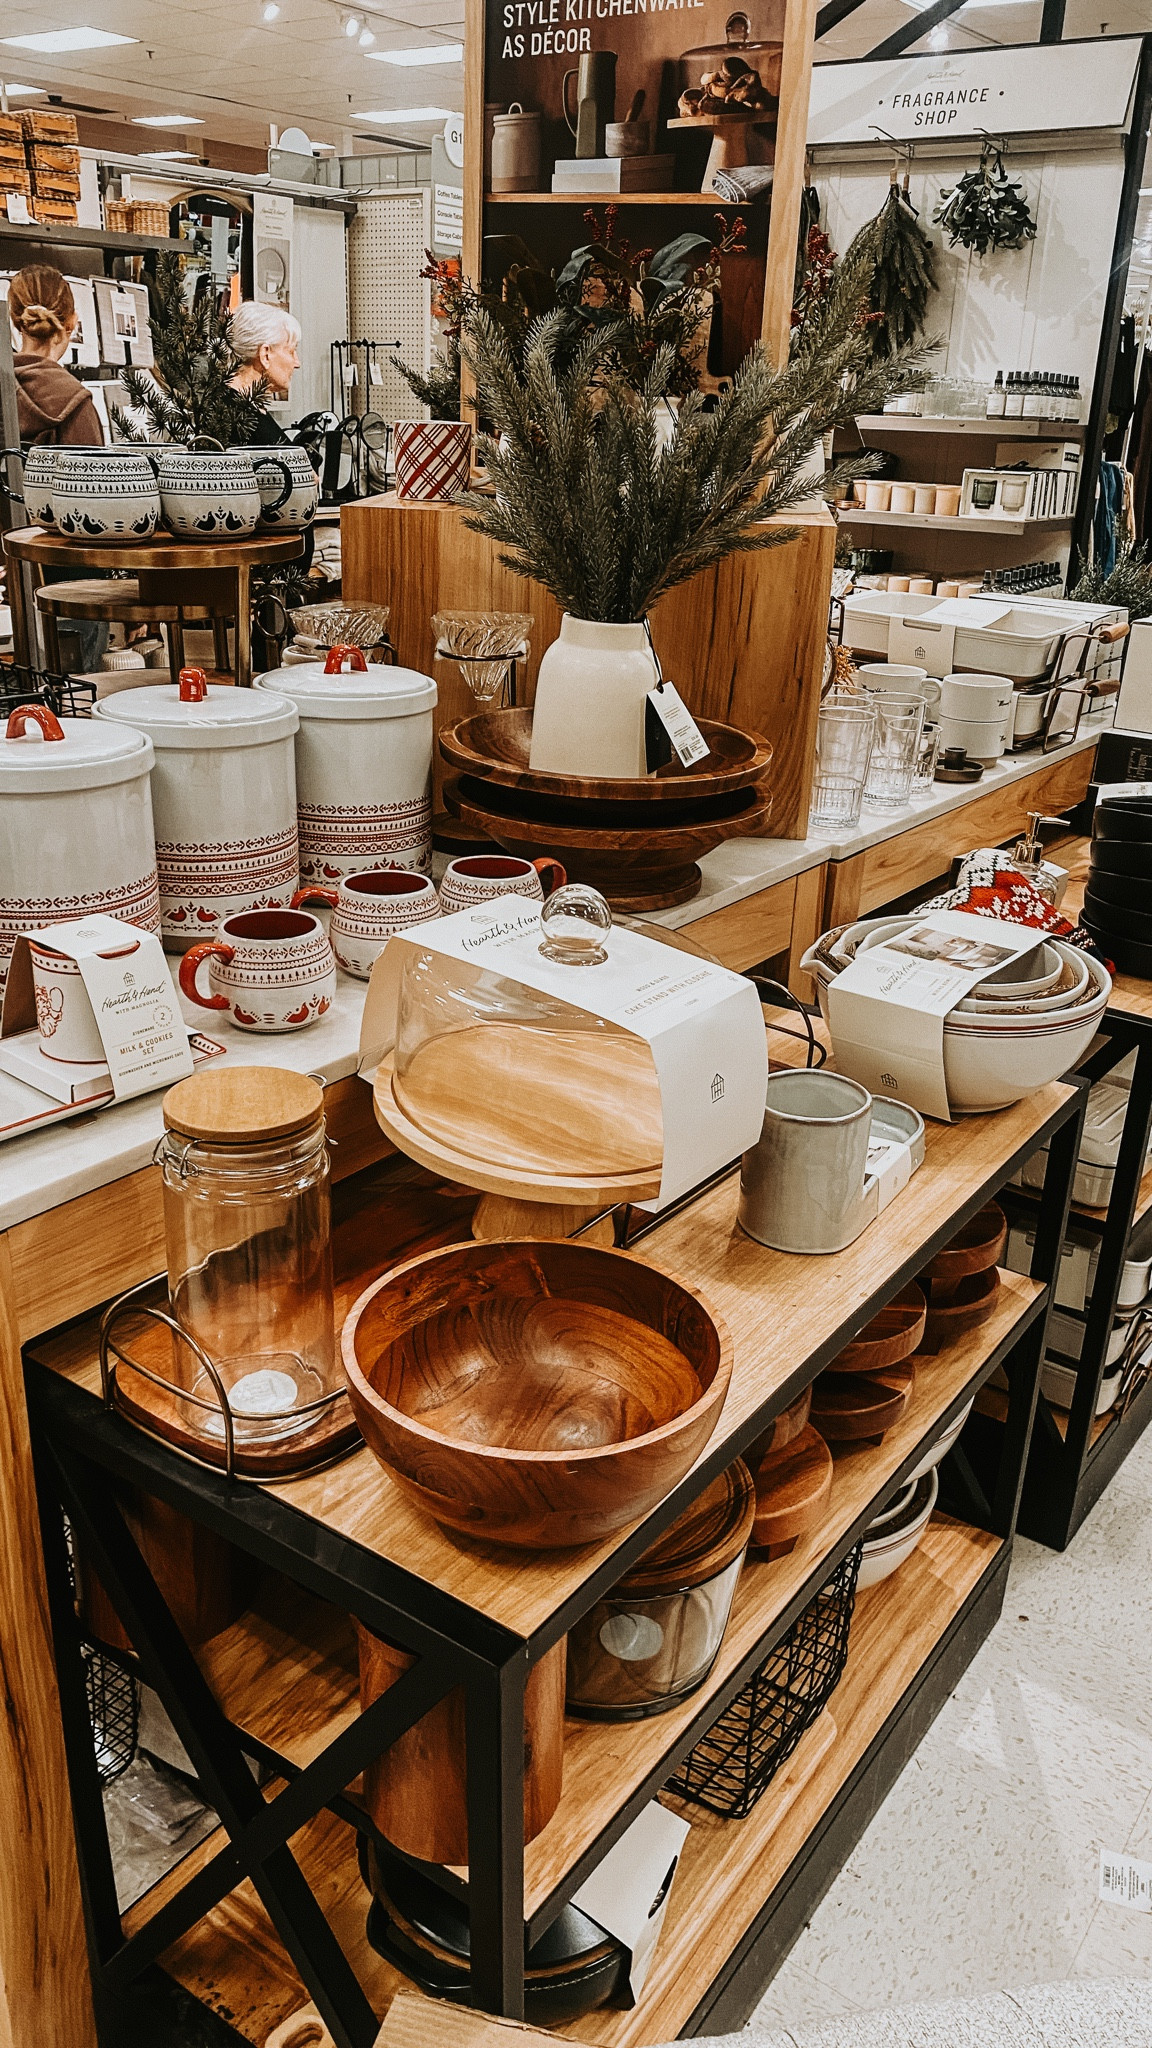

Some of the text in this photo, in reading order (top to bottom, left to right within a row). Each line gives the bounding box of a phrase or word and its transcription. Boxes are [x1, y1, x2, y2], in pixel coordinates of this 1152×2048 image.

[503, 1, 560, 28] STYLE
[502, 26, 591, 59] AS DÉCOR
[892, 88, 990, 109] FRAGRANCE
[914, 109, 958, 126] SHOP
[461, 923, 508, 952] Hearth
[517, 914, 540, 929] Han
[102, 988, 132, 1012] Hearth
[138, 980, 165, 1000] Hand
[624, 1003, 646, 1015] CAKE
[644, 991, 669, 1006] STAND
[666, 982, 688, 994] WITH
[684, 970, 713, 986] CLOCHE
[160, 1012, 165, 1021] 2
[119, 1044, 136, 1055] MILK
[145, 1032, 174, 1047] COOKIES
[142, 1046, 155, 1056] SET
